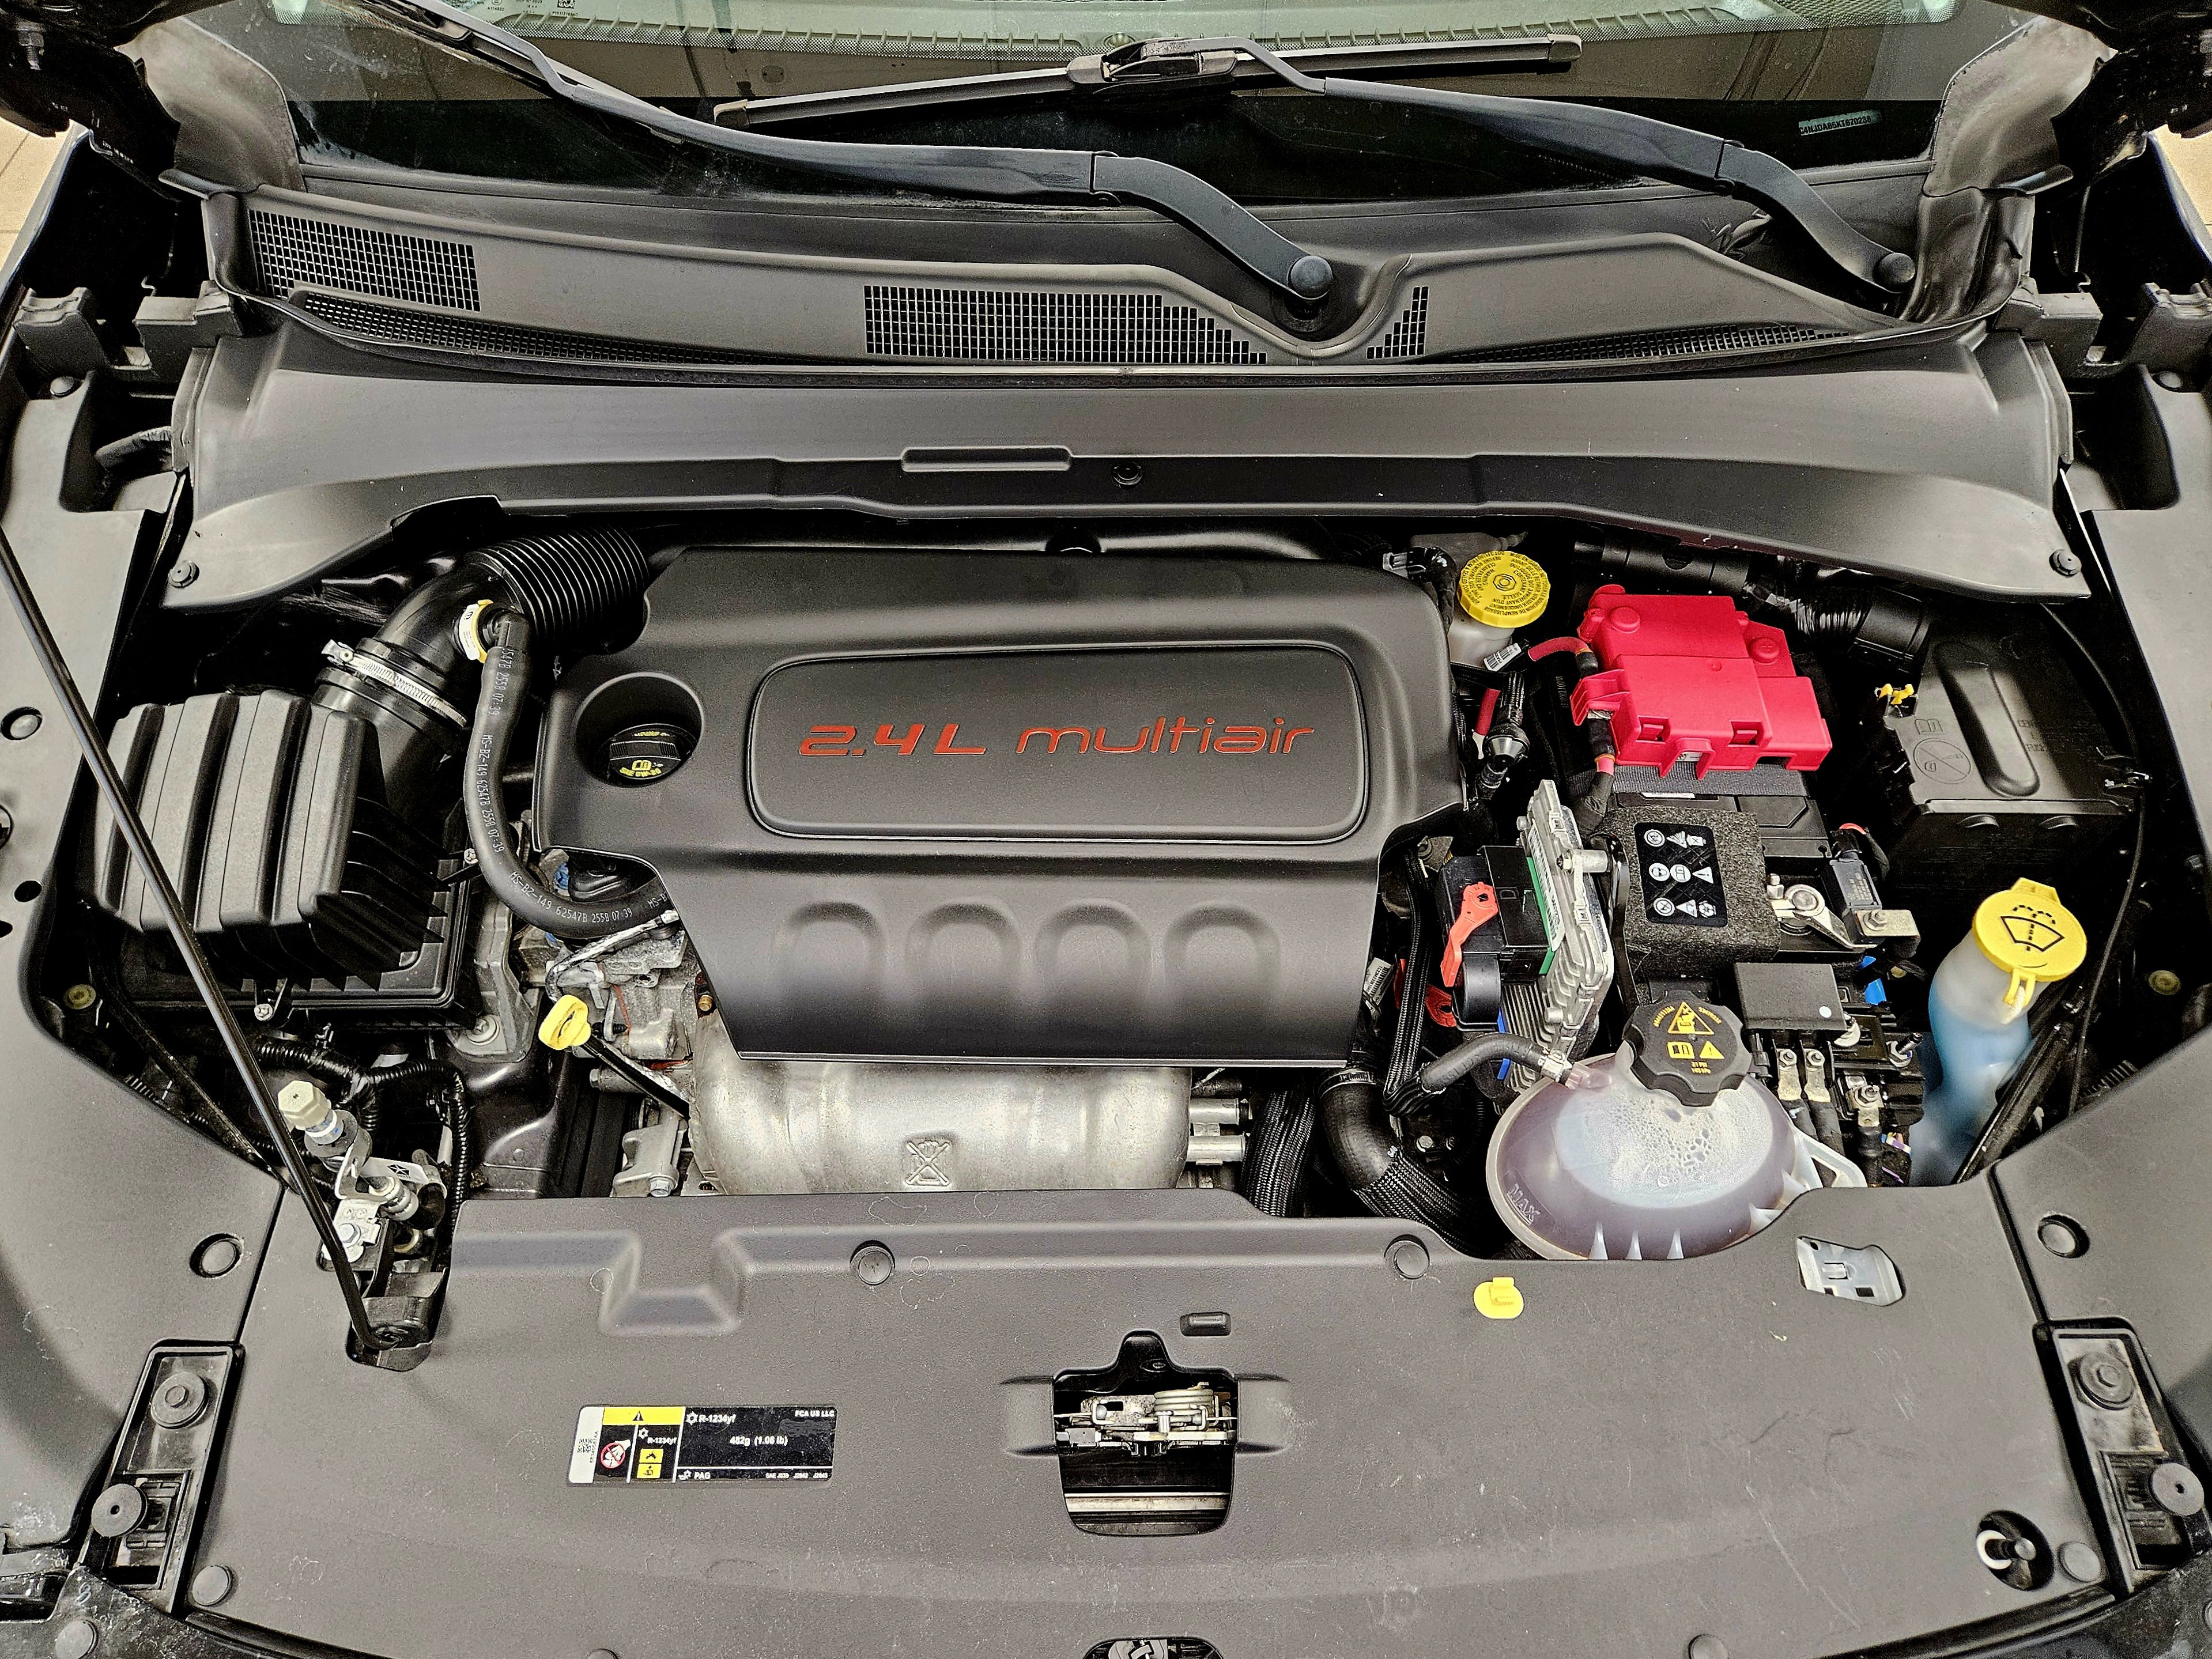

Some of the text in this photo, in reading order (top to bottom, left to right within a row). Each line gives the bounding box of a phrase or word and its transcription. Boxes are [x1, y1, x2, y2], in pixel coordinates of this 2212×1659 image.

[1016, 716, 1313, 753] multiair
[488, 829, 505, 853] 07:39
[611, 908, 632, 921] 07:39
[1507, 1182, 1541, 1222] MAX
[698, 1414, 736, 1424] R-1234yf
[729, 1435, 788, 1446] 482g (1.06 lb)
[694, 1472, 711, 1480] PAG
